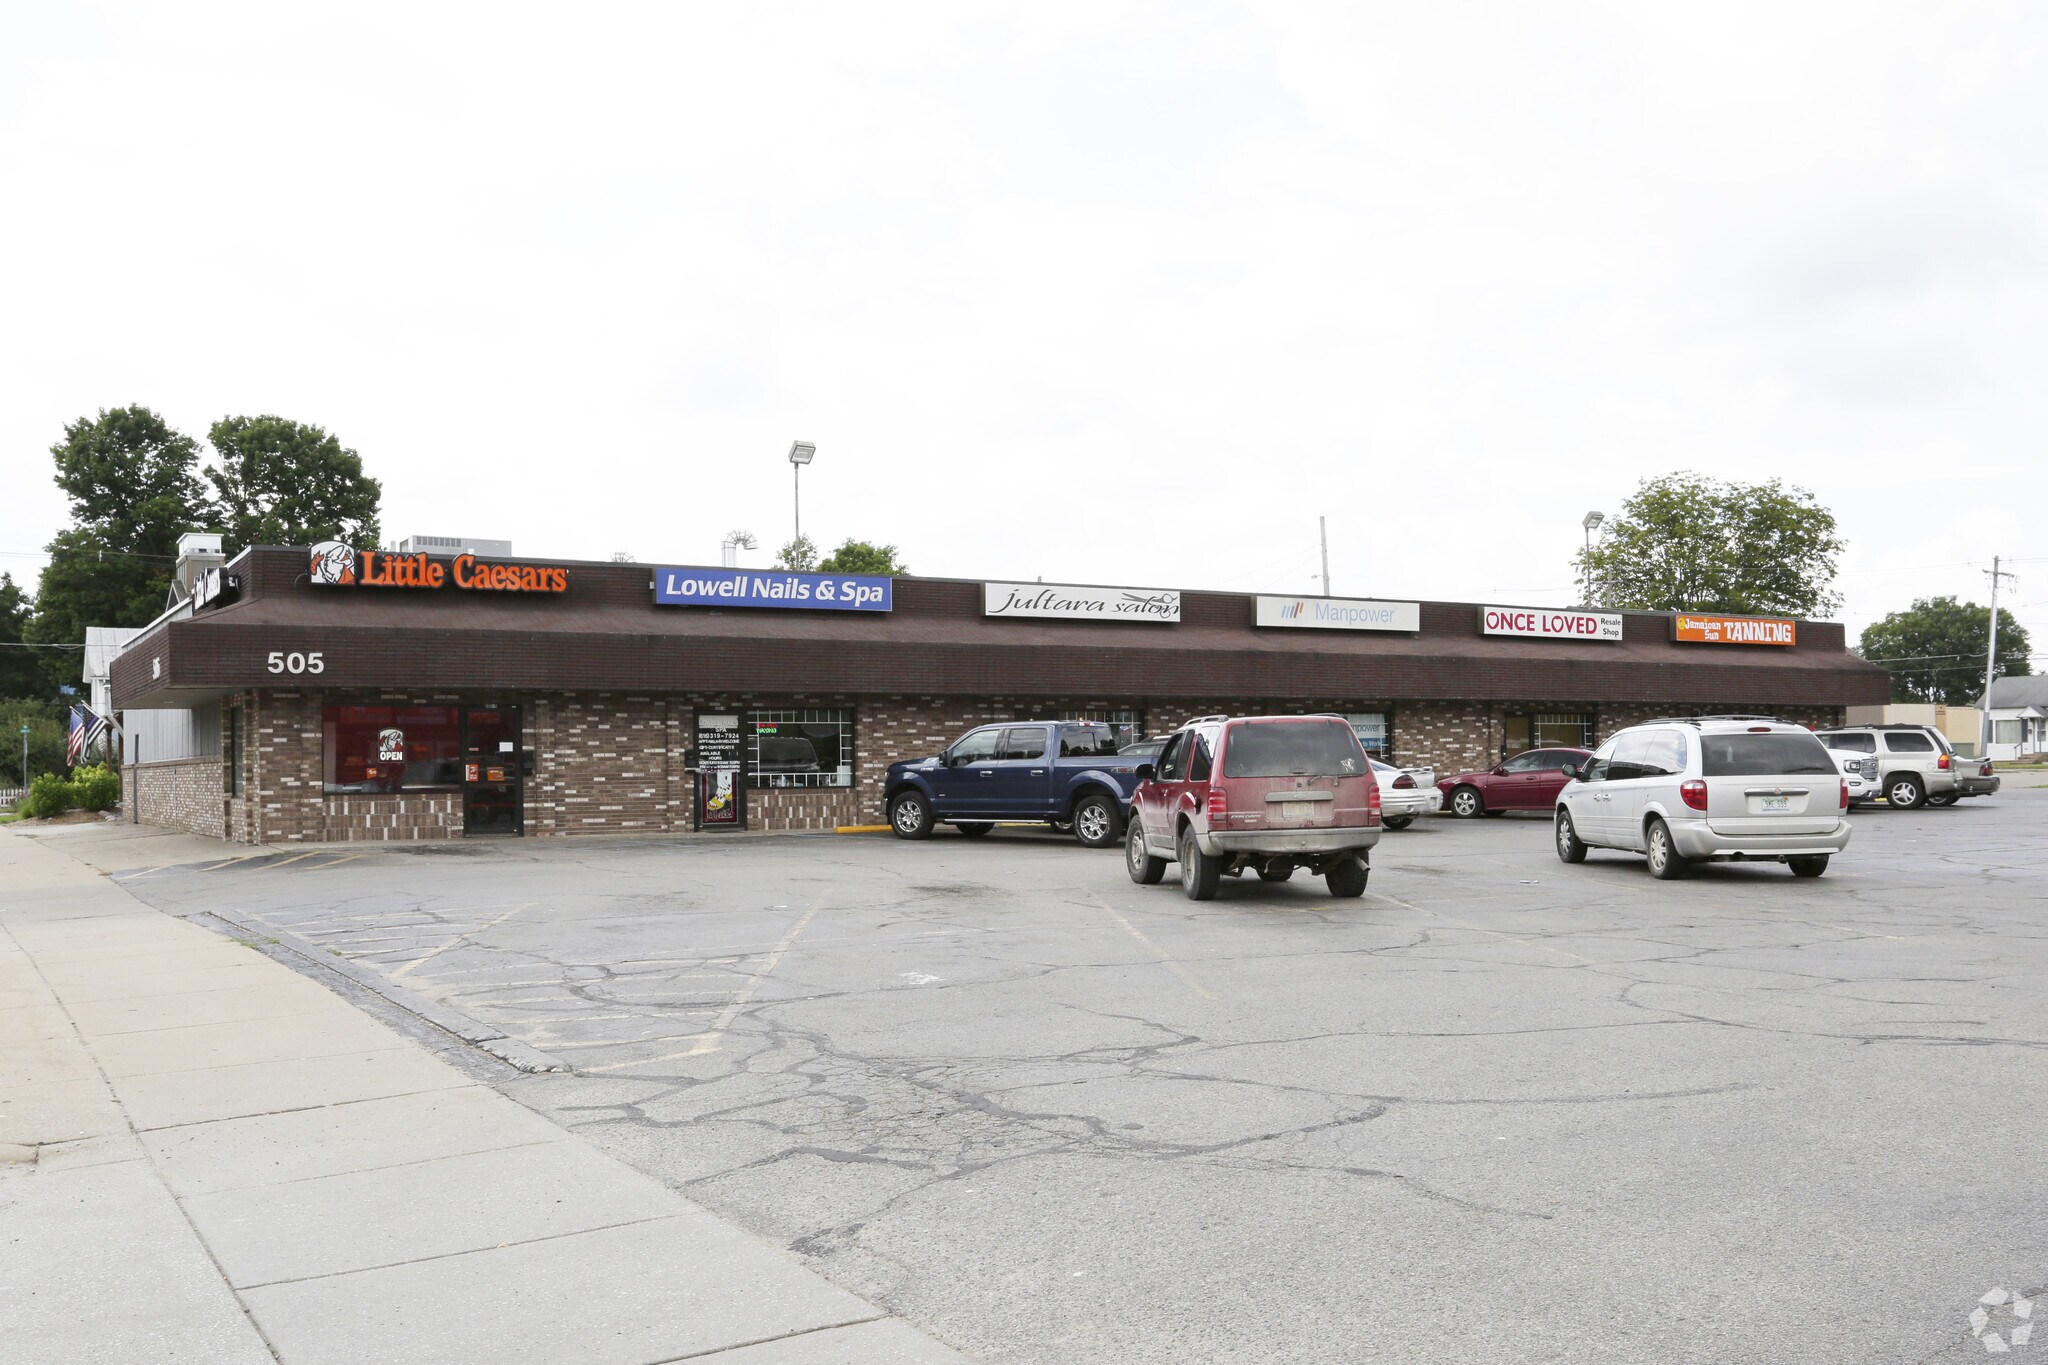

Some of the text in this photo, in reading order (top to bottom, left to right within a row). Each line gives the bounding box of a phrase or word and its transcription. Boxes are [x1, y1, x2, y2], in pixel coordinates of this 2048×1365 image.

[359, 550, 568, 593] Little Caesars
[666, 574, 884, 608] Lowell Nails & Spa
[988, 588, 1180, 615] jultara salon
[1315, 603, 1396, 625] Manpower
[1486, 611, 1598, 635] ONCE LOVED
[1600, 617, 1622, 626] Resale
[1685, 618, 1721, 631] Jamaican
[1602, 628, 1620, 637] Shop
[1705, 629, 1719, 640] Sun
[1724, 621, 1792, 643] TANNING
[267, 651, 325, 674] 505
[380, 751, 403, 761] OPEN
